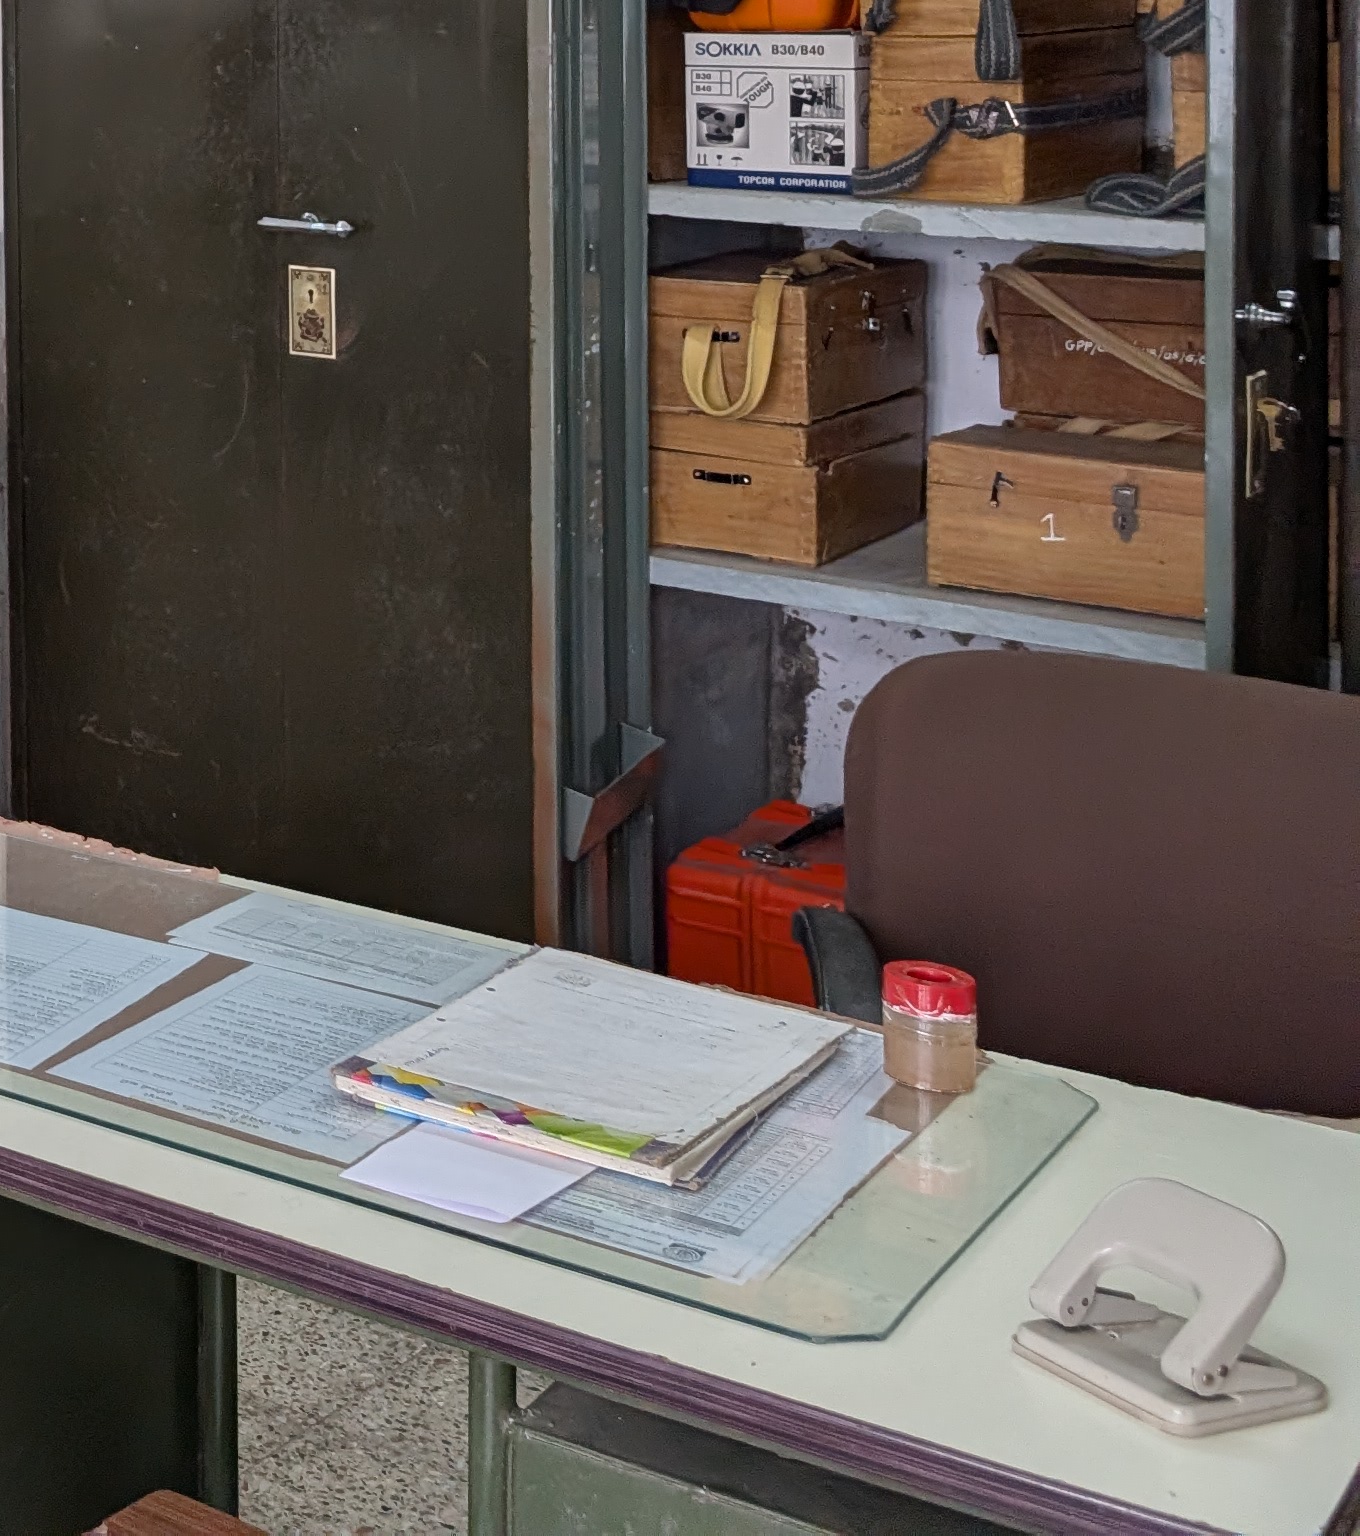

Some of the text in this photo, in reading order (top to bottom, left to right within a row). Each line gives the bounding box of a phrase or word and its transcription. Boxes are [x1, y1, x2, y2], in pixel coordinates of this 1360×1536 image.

[695, 41, 825, 57] SOKKIA B30/B40
[743, 80, 773, 104] TOUGH
[738, 175, 846, 188] TOPCON CORPORATION
[1040, 513, 1066, 541] 1
